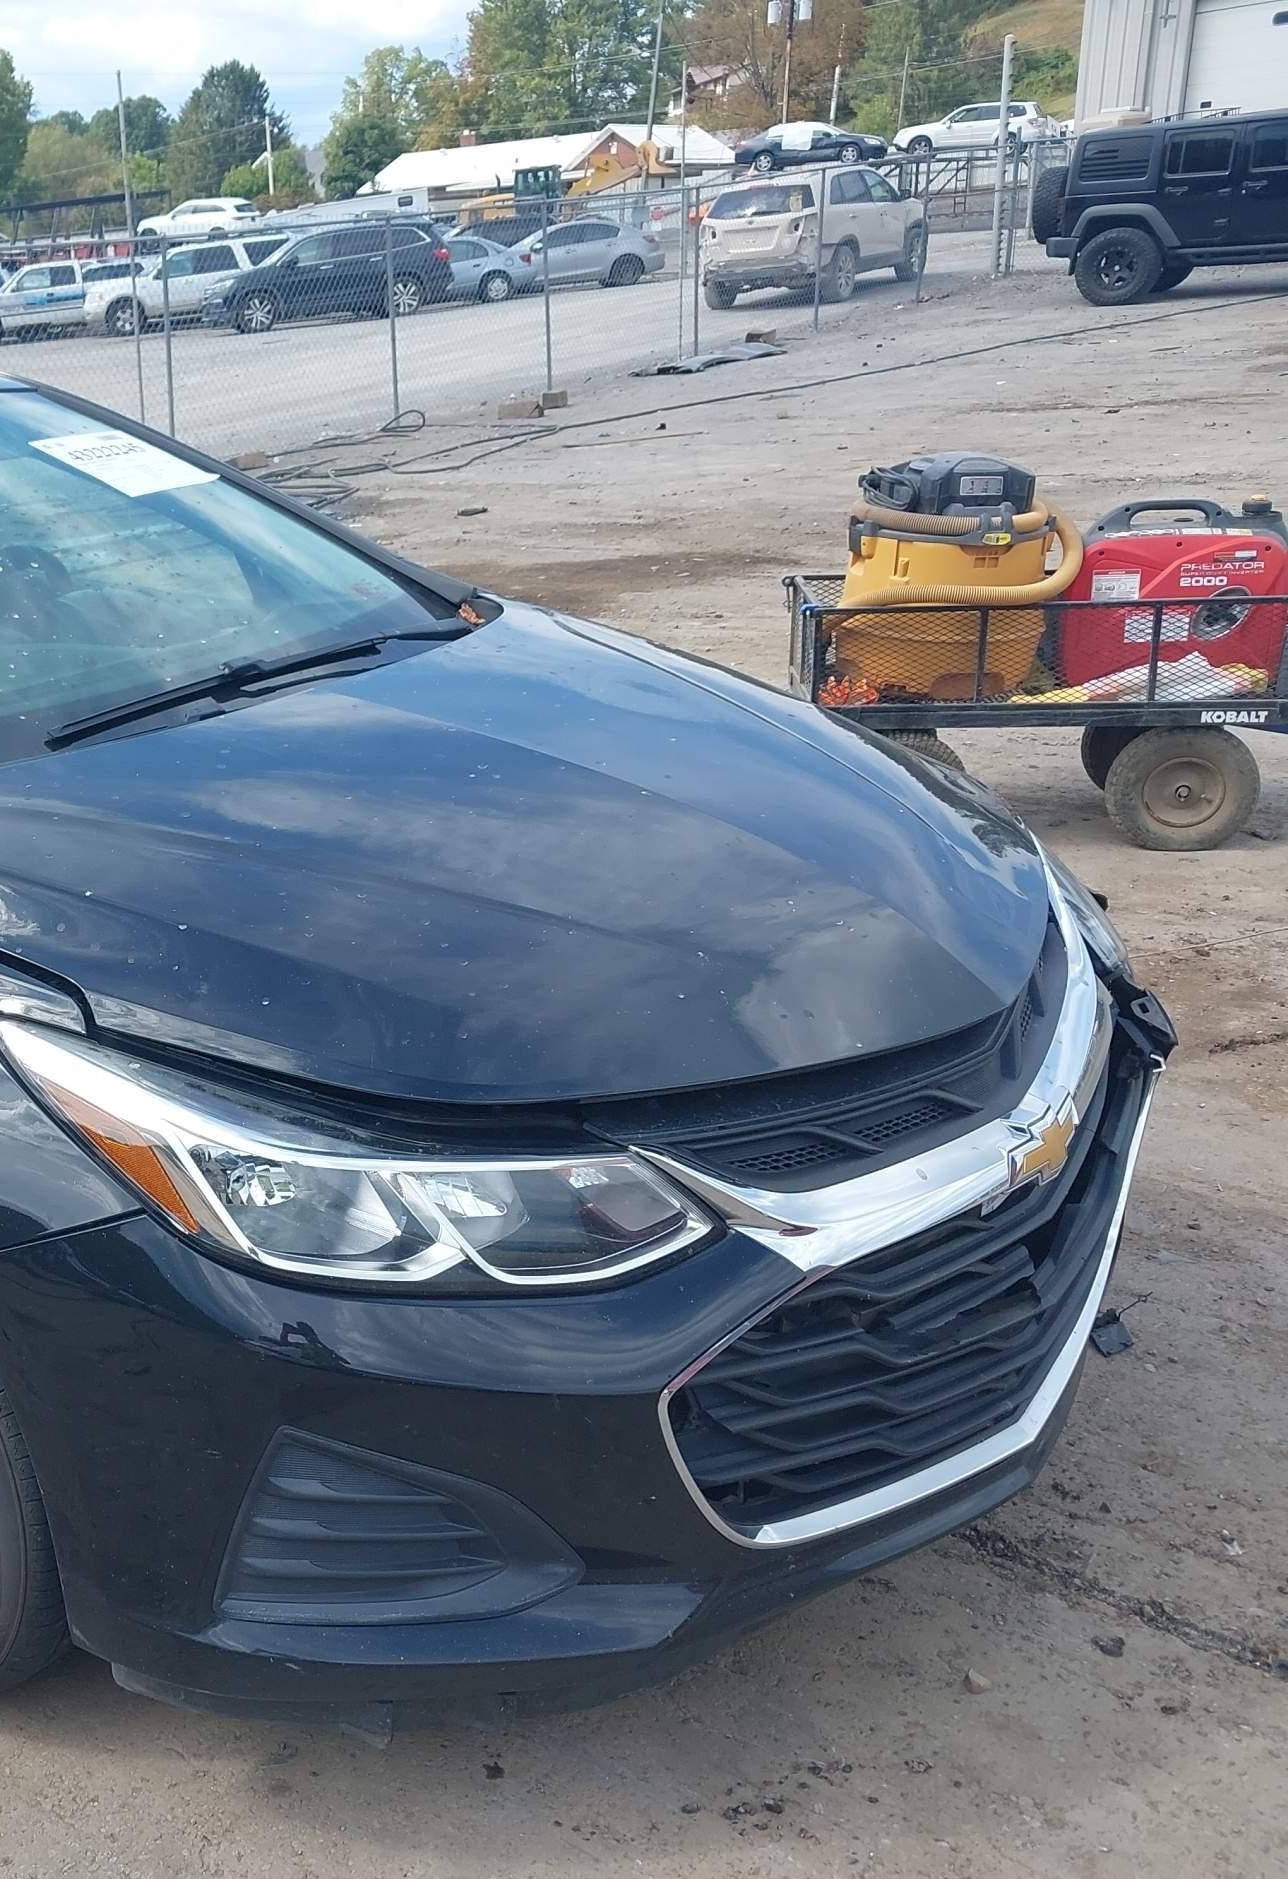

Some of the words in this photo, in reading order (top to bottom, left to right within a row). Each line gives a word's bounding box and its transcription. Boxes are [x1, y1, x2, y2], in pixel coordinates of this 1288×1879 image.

[1180, 560, 1265, 572] PREDATOR
[1179, 576, 1228, 587] 2000
[1200, 710, 1269, 724] KOBALT
